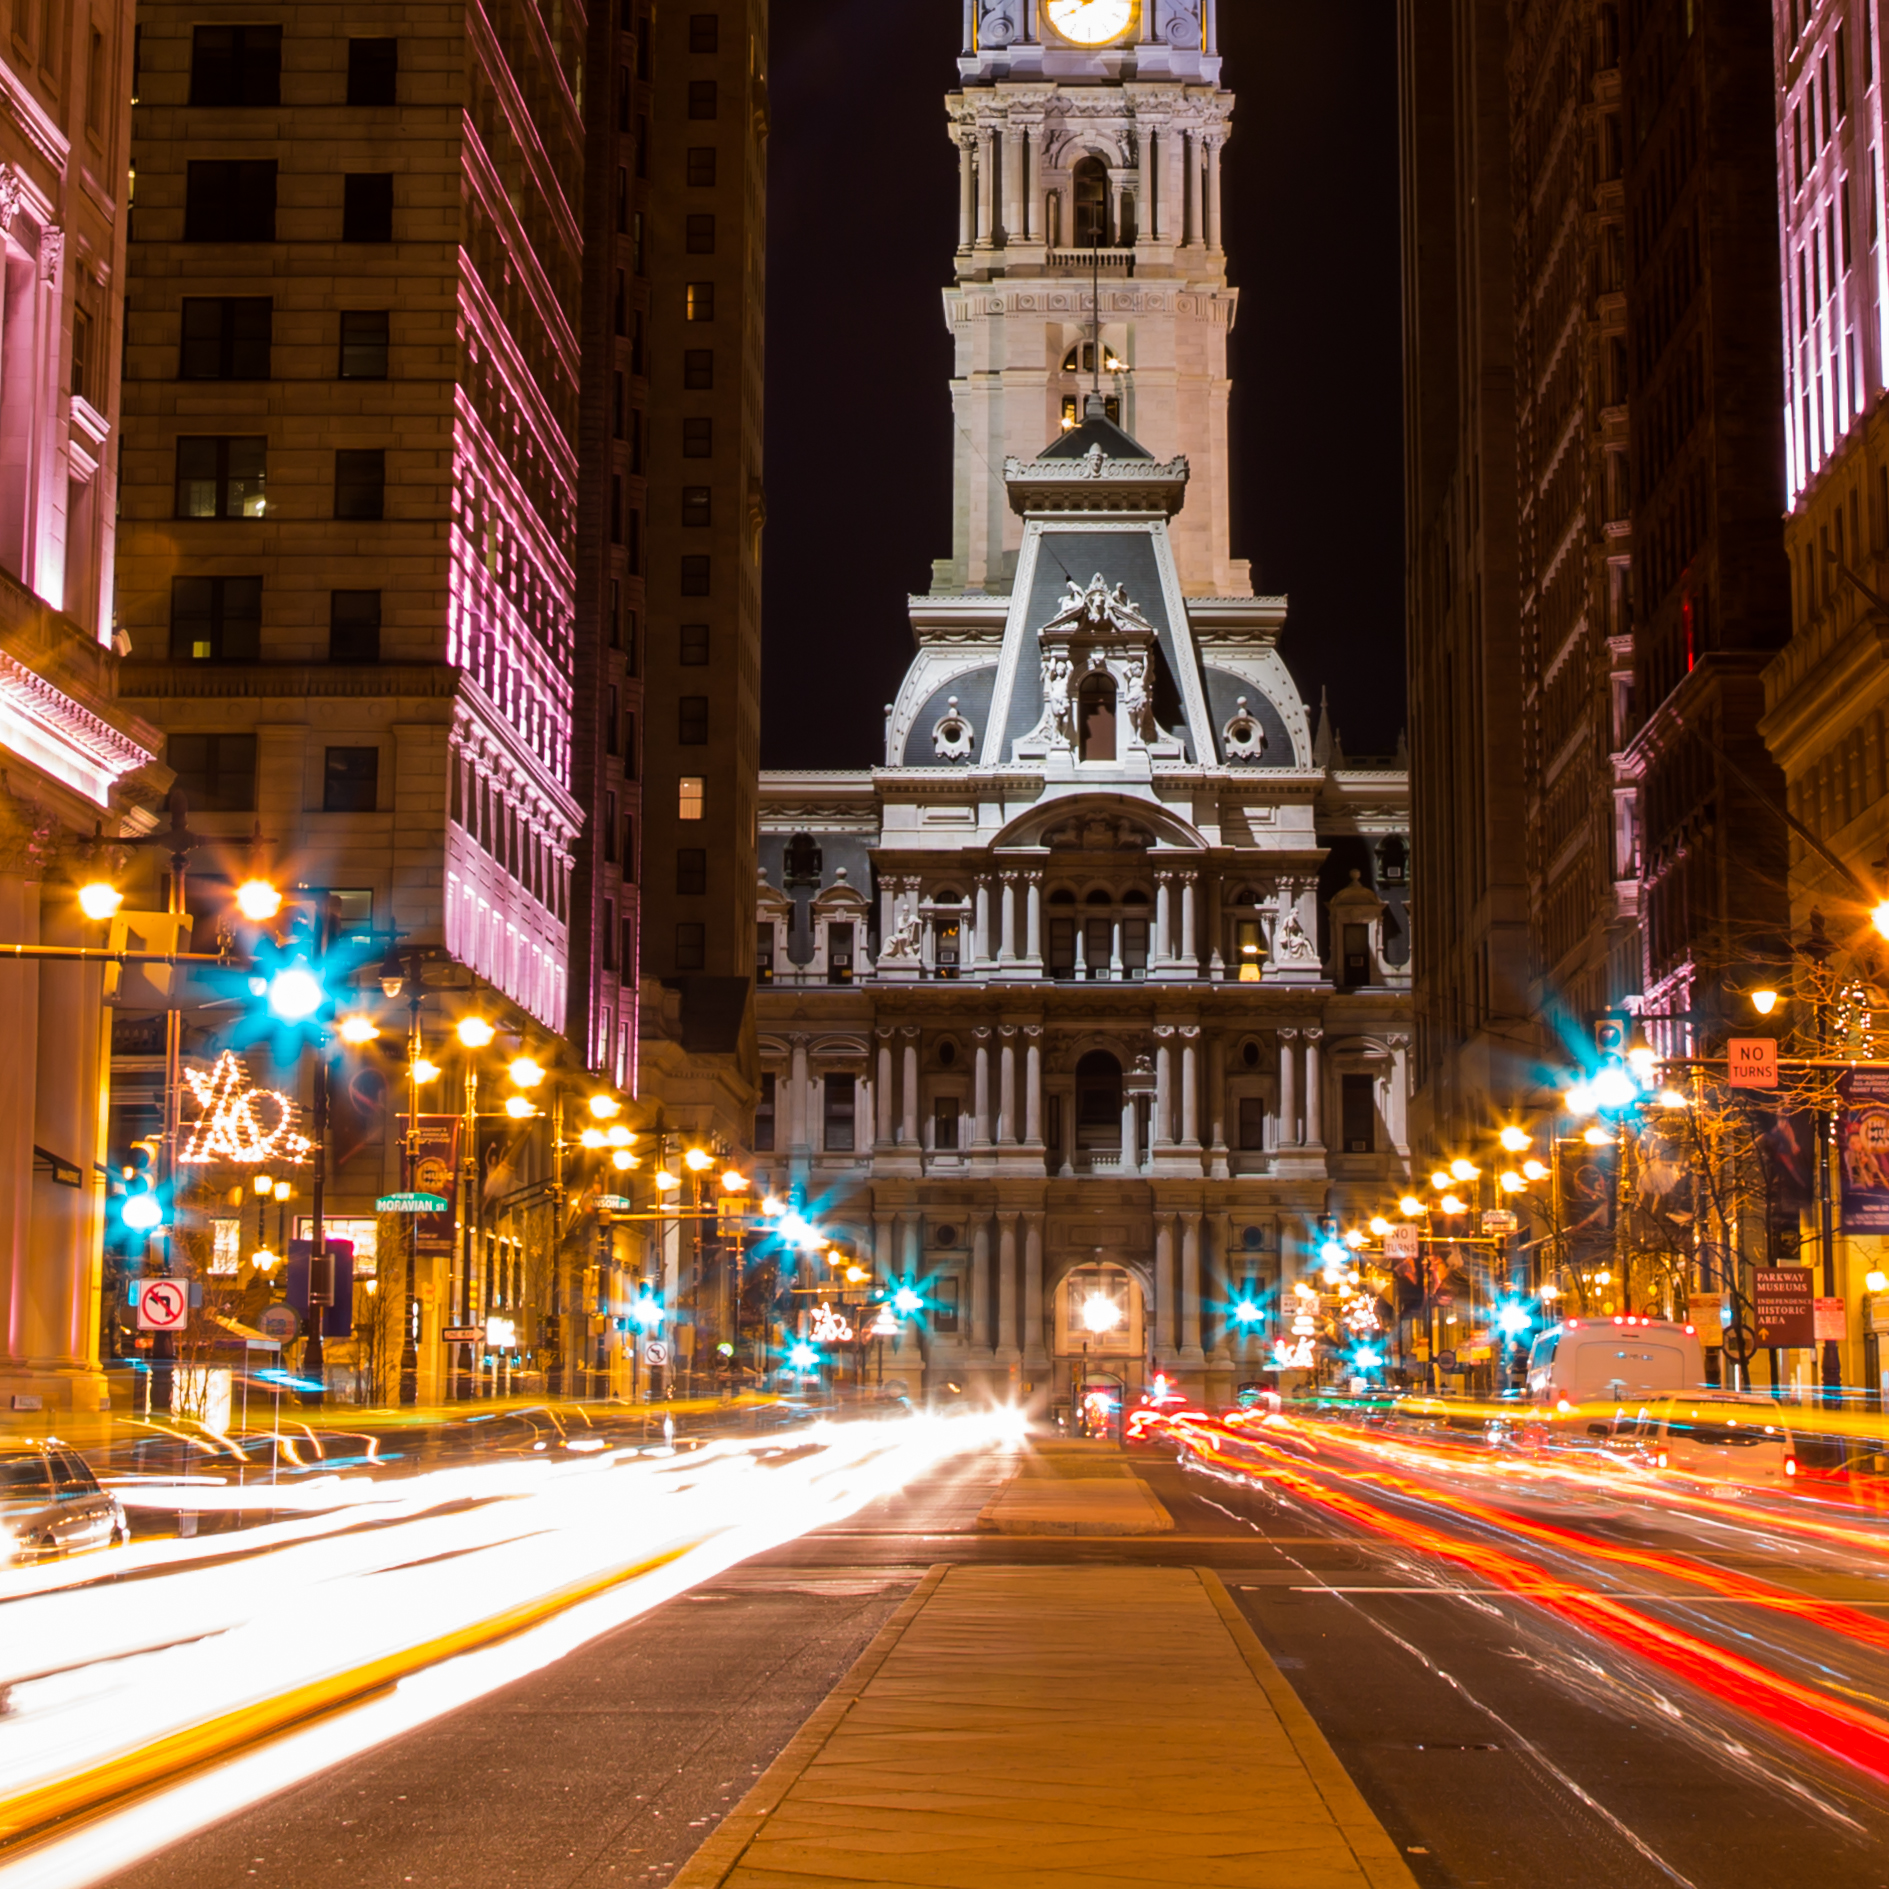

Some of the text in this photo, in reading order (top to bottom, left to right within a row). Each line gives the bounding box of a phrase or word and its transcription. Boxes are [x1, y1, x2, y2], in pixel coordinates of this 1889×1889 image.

[1740, 1046, 1764, 1061] NO
[1733, 1066, 1772, 1077] TURNS
[377, 1200, 445, 1211] MORAVIAN ST
[1386, 1244, 1416, 1252] TURNS
[1757, 1273, 1805, 1282] PARKWAY
[1757, 1283, 1808, 1292] MUSEUMS
[1757, 1306, 1806, 1315] HISTORIC
[1758, 1316, 1785, 1325] AREA
